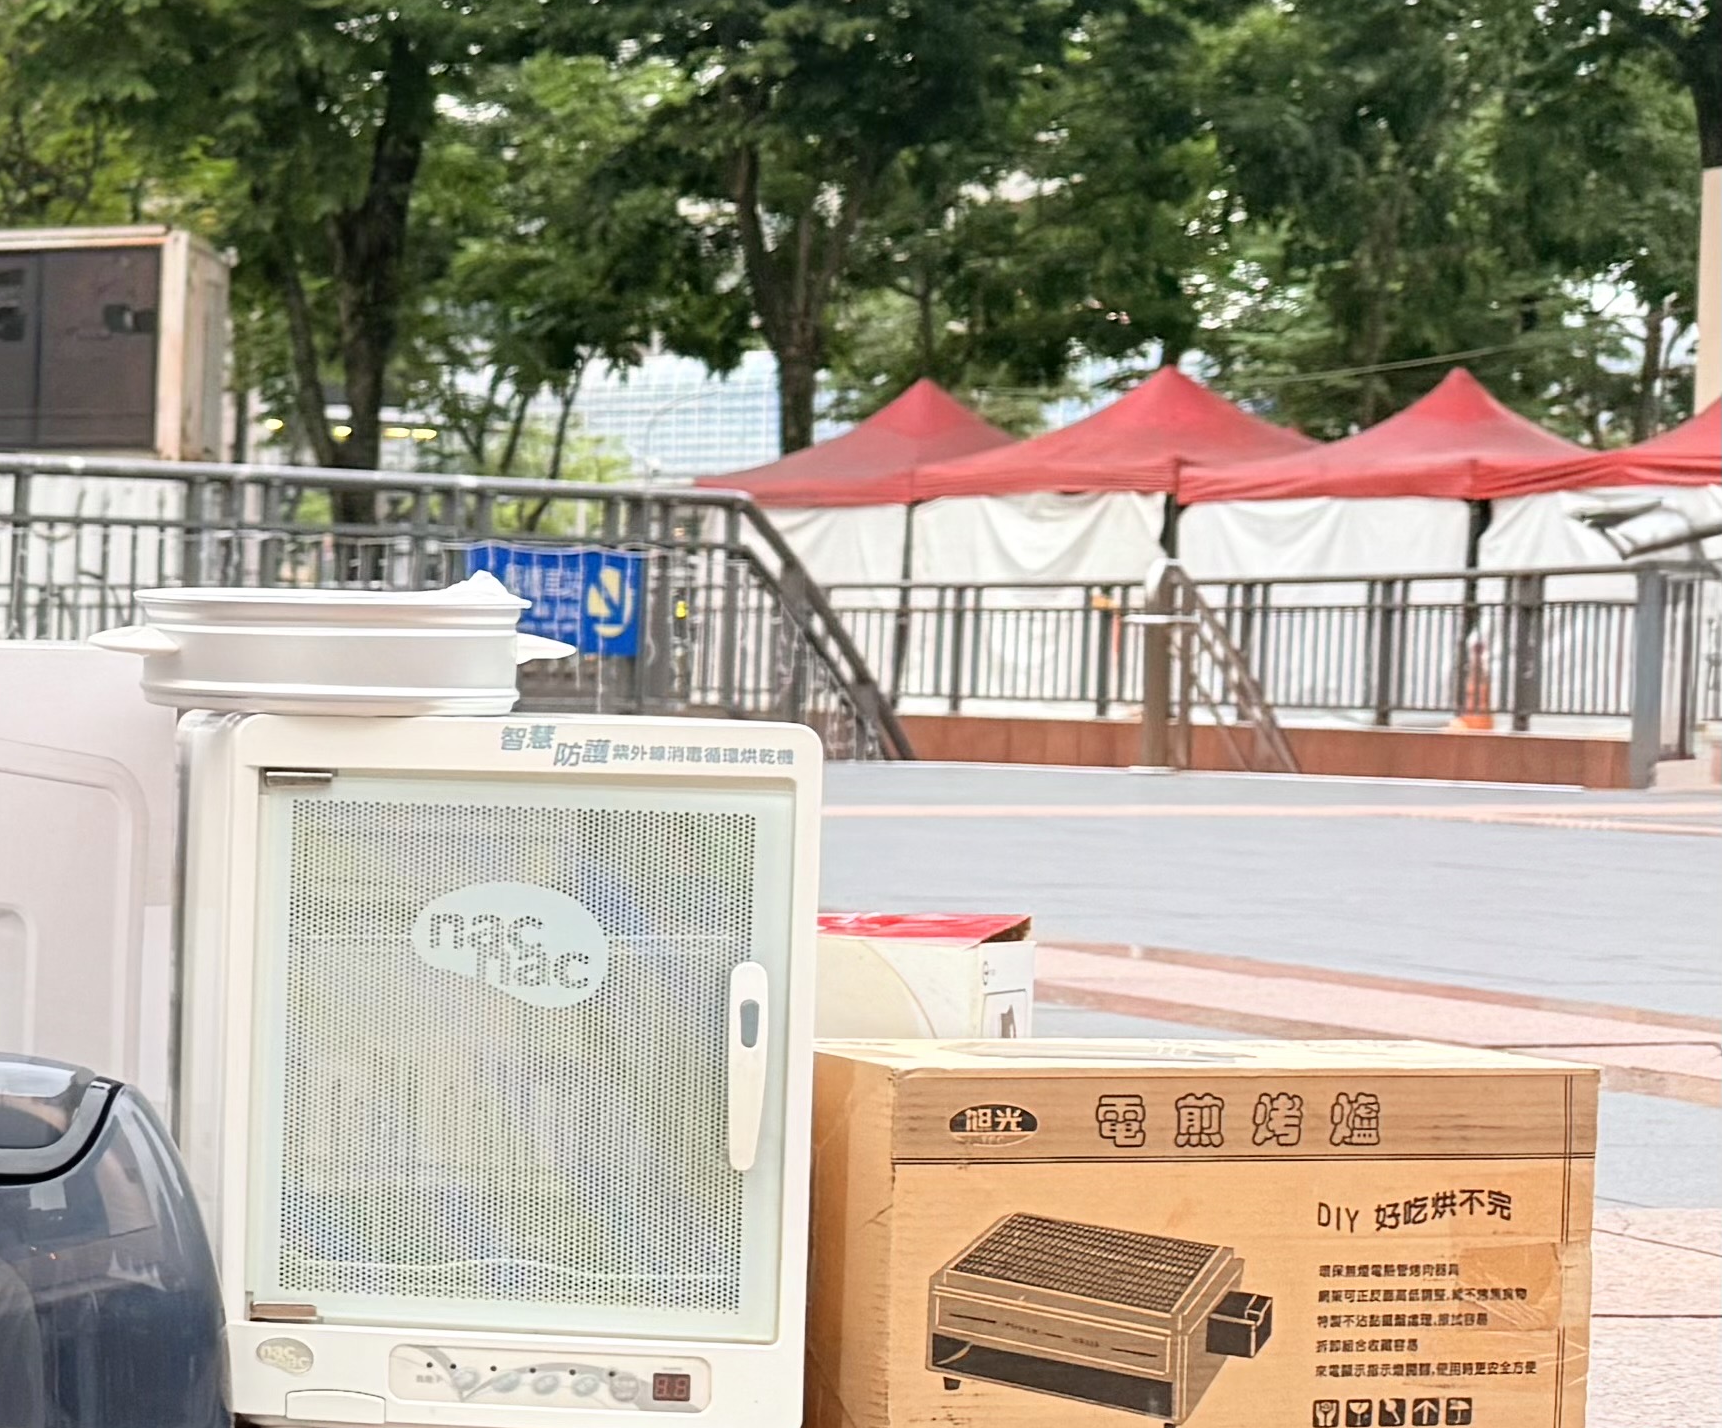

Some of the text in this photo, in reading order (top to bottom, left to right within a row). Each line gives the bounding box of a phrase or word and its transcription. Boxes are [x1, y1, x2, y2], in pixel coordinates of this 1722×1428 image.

[500, 724, 556, 751] 智慧
[553, 738, 612, 767] 防護
[430, 913, 544, 950] nac
[476, 943, 589, 989] nac
[964, 1107, 1023, 1133] 旭光
[1096, 1093, 1380, 1148] 電煎烤爐
[1317, 1188, 1512, 1233] DIY 好吃烘不完
